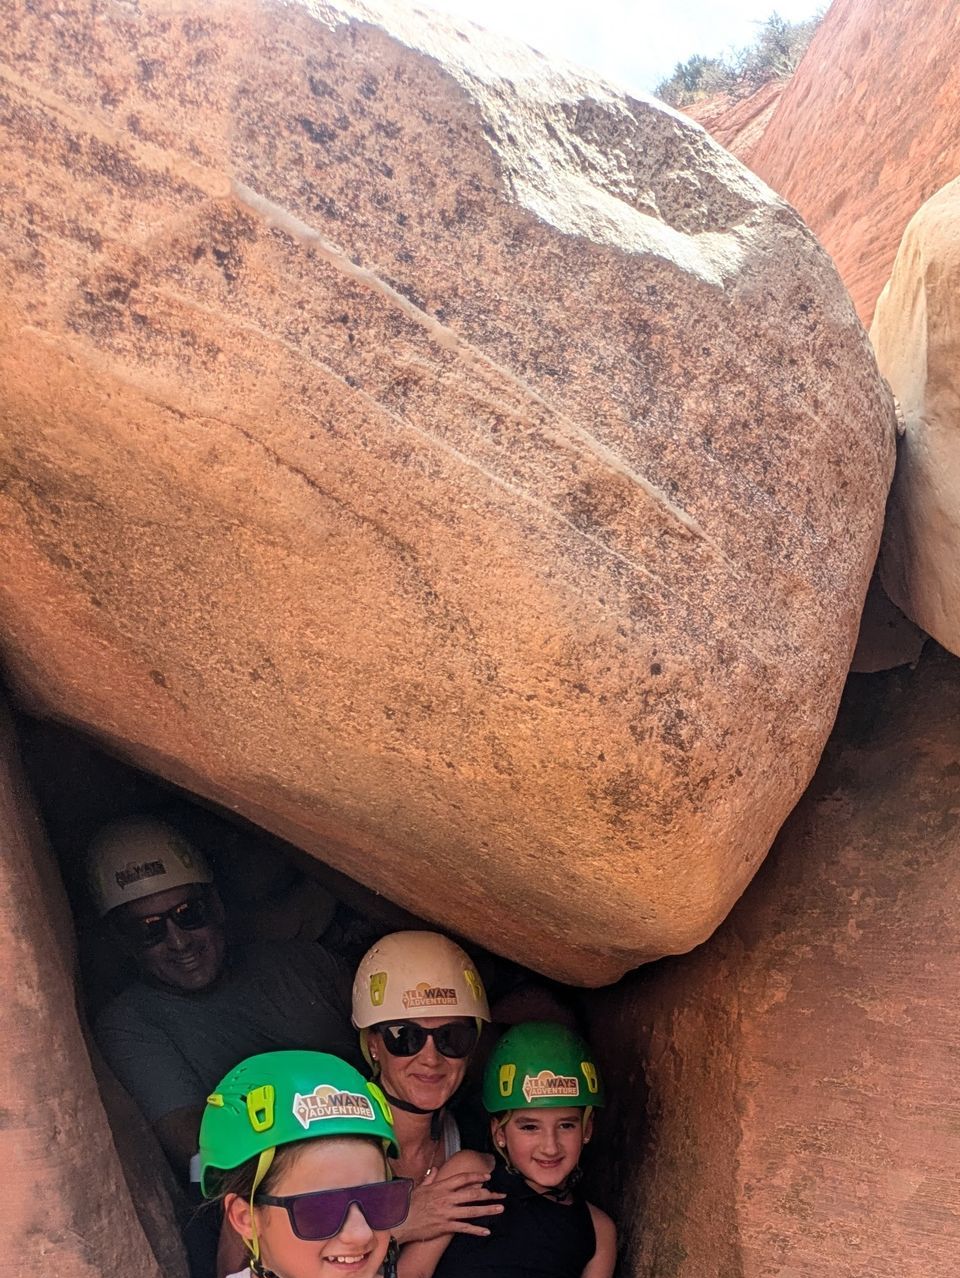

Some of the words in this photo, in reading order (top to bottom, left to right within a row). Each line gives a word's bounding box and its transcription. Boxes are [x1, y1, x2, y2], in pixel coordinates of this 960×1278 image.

[402, 991, 423, 1000] ALL
[424, 988, 456, 998] WAYS
[409, 998, 457, 1006] ADVENTURE
[525, 1080, 545, 1088] ALL
[546, 1079, 577, 1088] WAYS
[531, 1087, 577, 1095] ADVENTURE
[296, 1096, 327, 1109] ALL
[327, 1093, 370, 1109] WAYS
[309, 1105, 372, 1118] ADVENTURE
